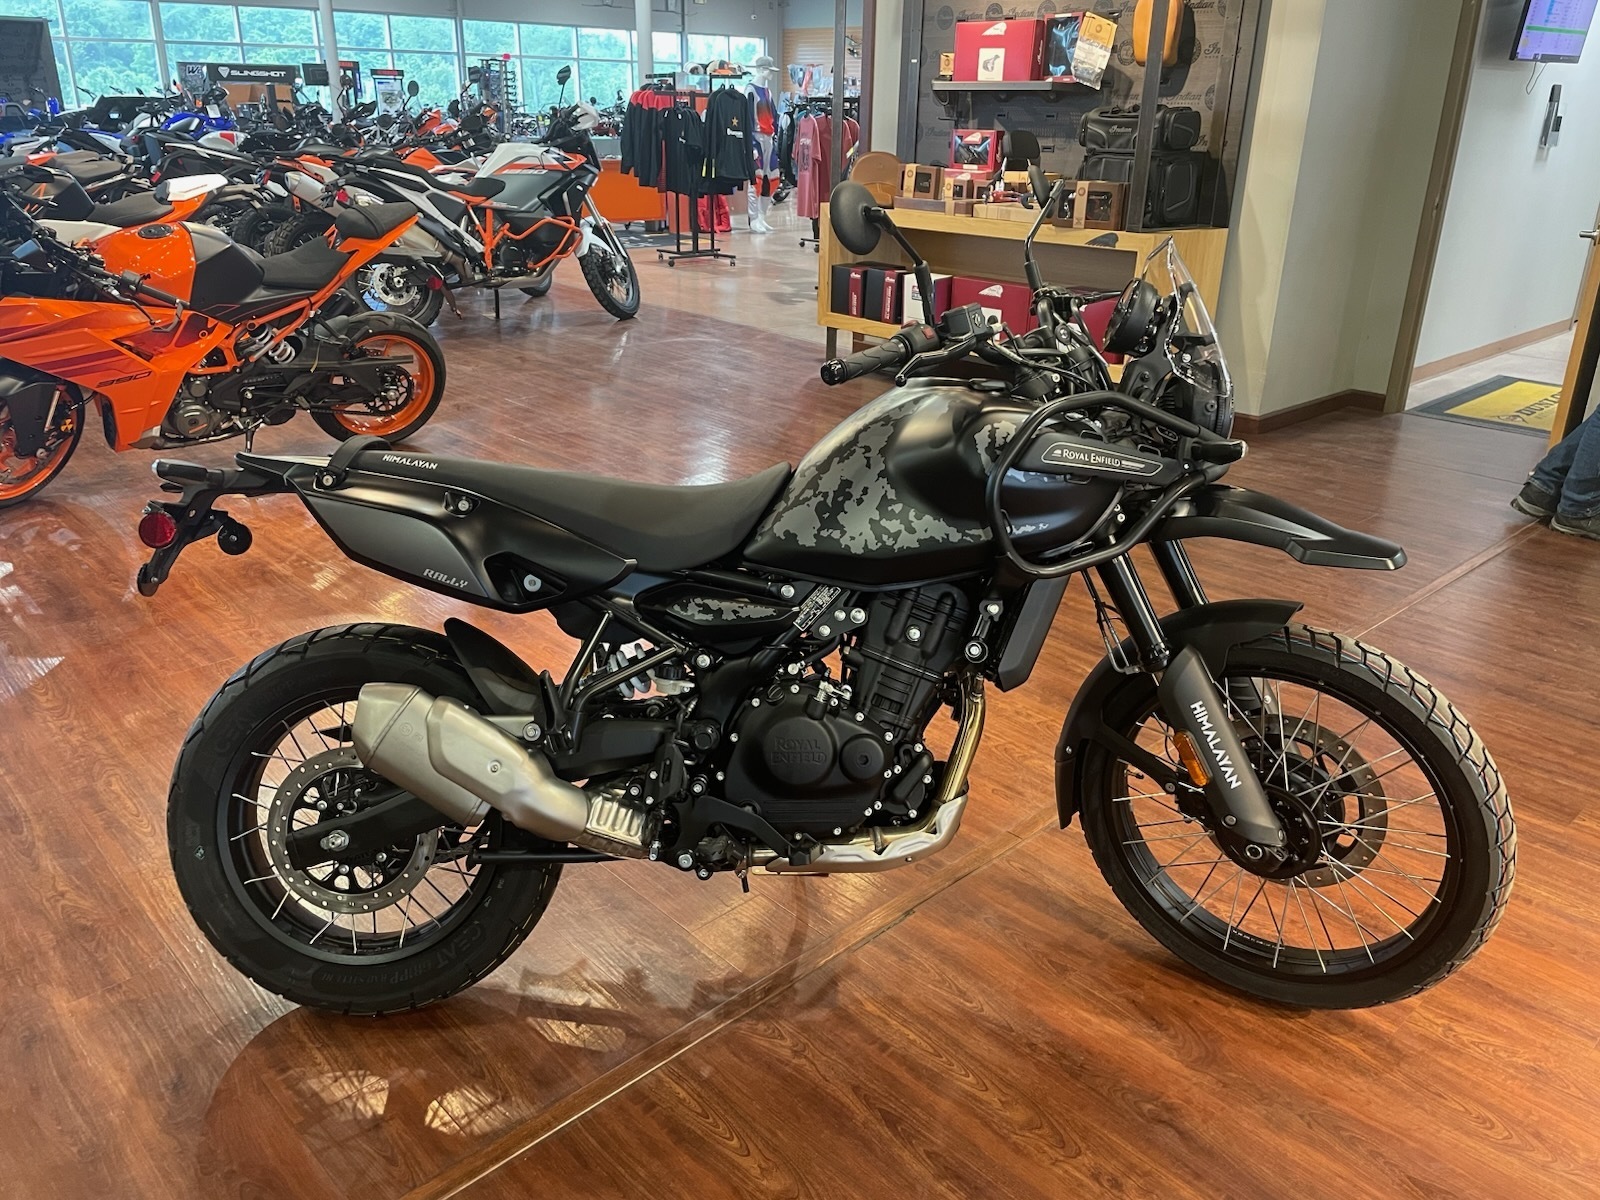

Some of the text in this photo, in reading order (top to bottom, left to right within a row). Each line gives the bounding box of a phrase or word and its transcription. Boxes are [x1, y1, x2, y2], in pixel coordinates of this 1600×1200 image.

[382, 454, 438, 470] HIMALAYAN
[1063, 449, 1121, 467] ROYAL ENFIELD
[423, 568, 468, 588] RALLY
[774, 736, 821, 751] ROYAL
[1190, 700, 1242, 789] HIMALAYAN
[770, 751, 827, 766] ENFIELD
